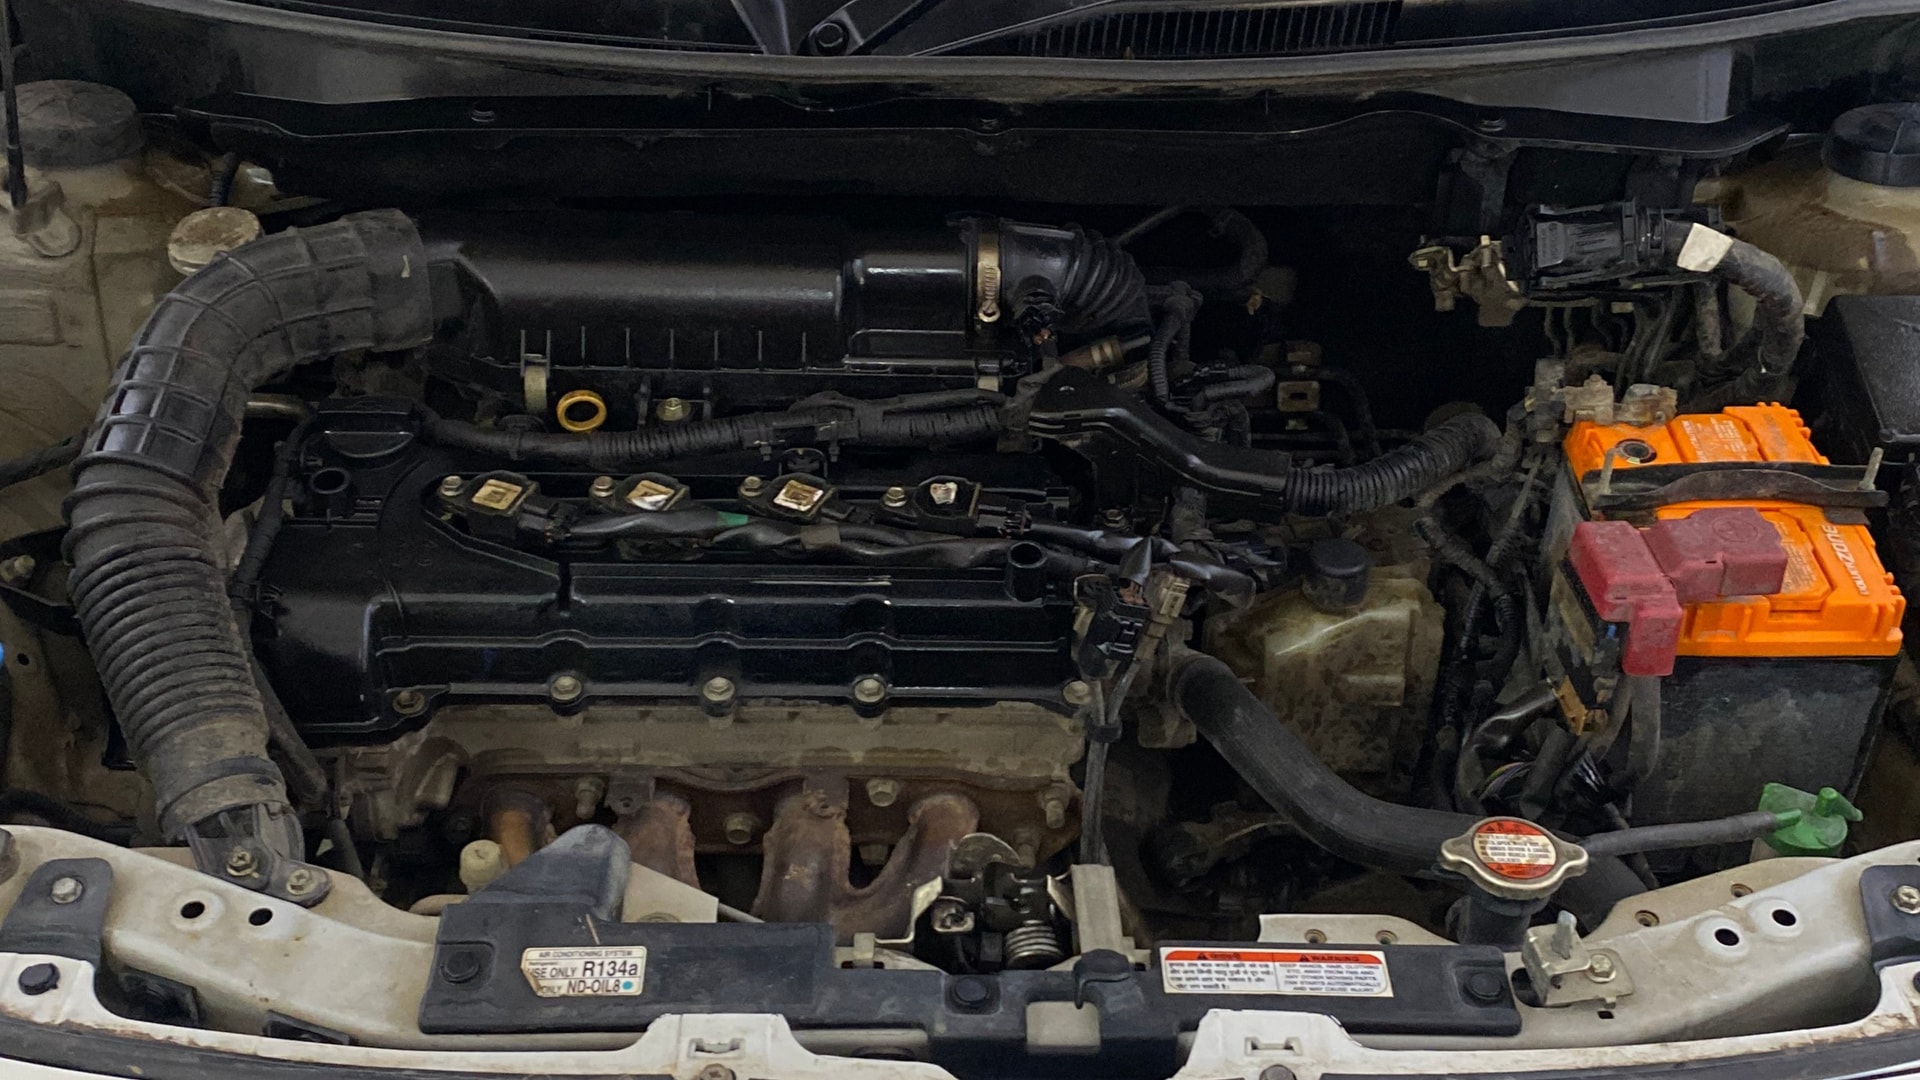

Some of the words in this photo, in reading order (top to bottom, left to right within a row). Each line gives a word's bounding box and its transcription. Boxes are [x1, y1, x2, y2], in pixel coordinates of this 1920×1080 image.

[550, 966, 577, 978] ONLY
[582, 960, 638, 977] R134a
[541, 985, 562, 993] ONLY
[567, 979, 620, 993] ND-OIL8
